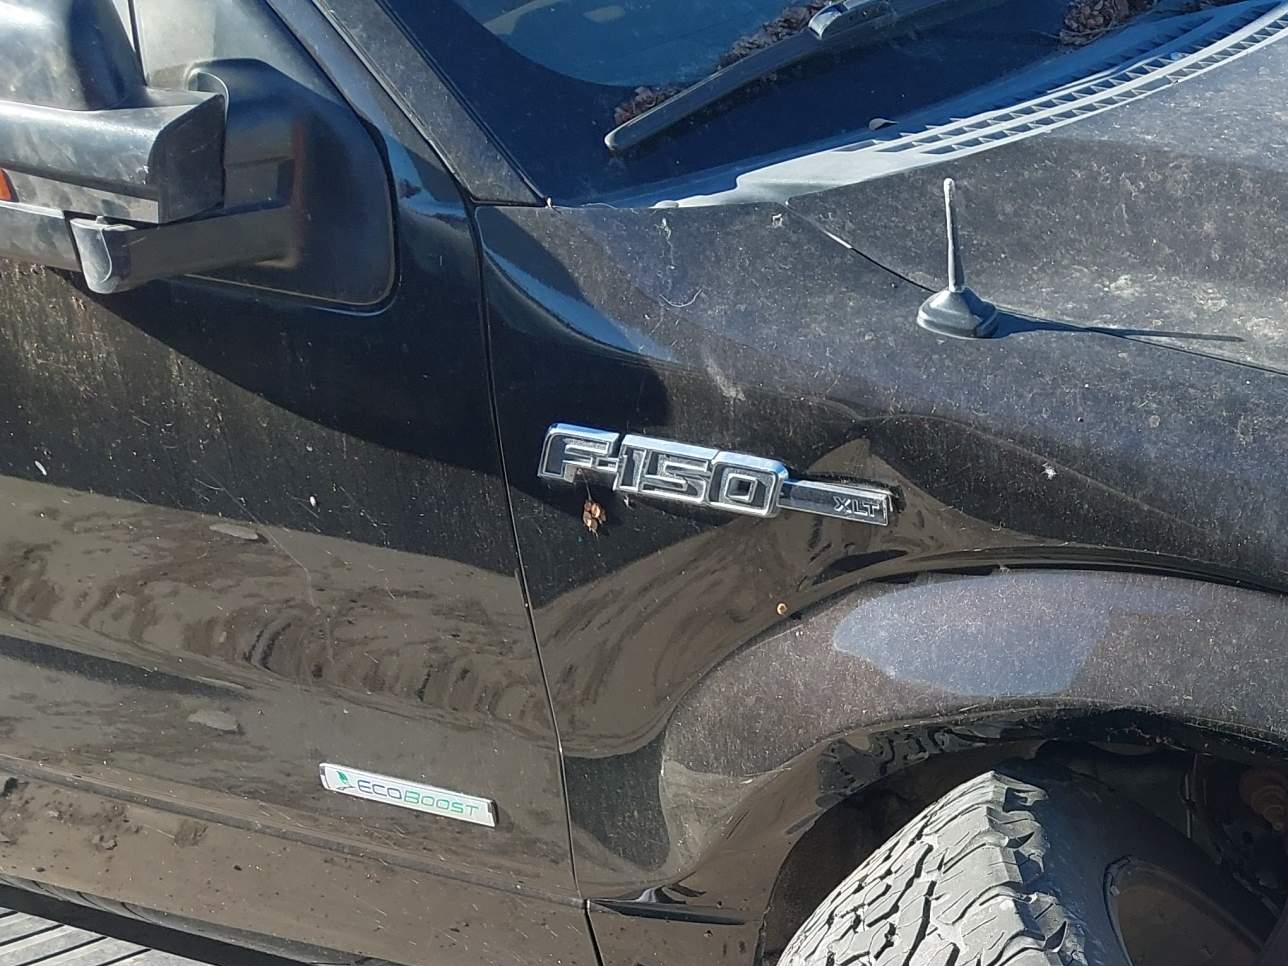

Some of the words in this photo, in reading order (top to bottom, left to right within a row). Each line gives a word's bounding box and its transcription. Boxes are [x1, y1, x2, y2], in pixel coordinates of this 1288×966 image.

[538, 423, 788, 517] F-150
[832, 495, 880, 518] XLT
[357, 779, 479, 816] ECOBOOST
